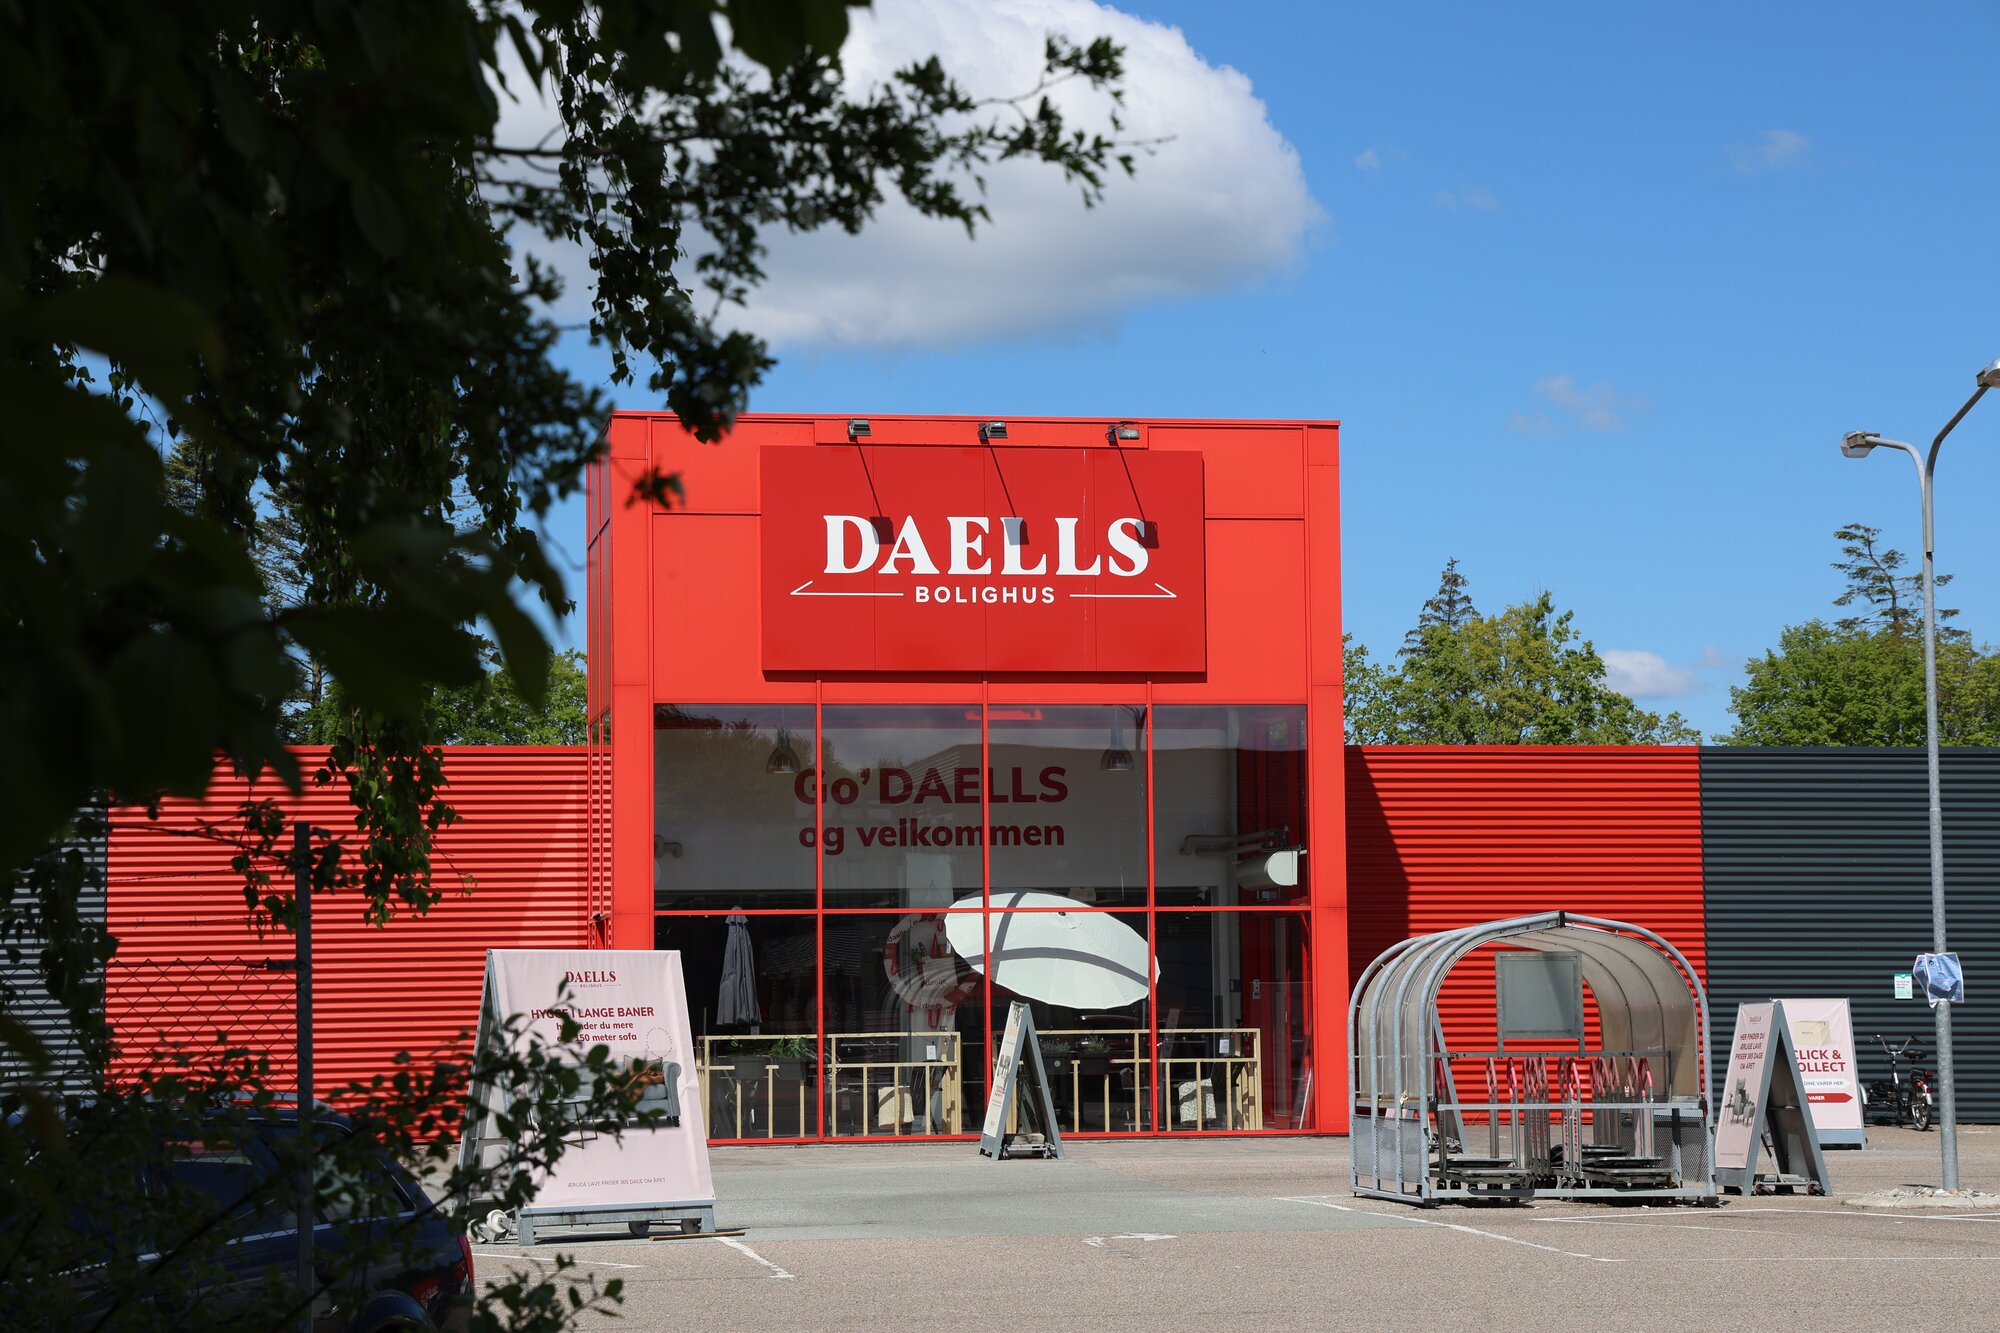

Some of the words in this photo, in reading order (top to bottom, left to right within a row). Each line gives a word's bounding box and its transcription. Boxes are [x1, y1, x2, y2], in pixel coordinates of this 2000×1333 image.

[823, 514, 1149, 577] DAELLS
[915, 586, 1055, 604] BOLIGHUS
[798, 826, 845, 856] og
[856, 818, 1065, 847] velkommen
[566, 971, 617, 983] DAELLS
[531, 1008, 568, 1019] HYG
[578, 1007, 614, 1018] LANGE
[617, 1007, 654, 1017] BANER
[600, 1022, 610, 1030] du
[618, 1033, 637, 1041] sofa
[1832, 1049, 1842, 1060] &
[1797, 1062, 1846, 1072] OLLECT
